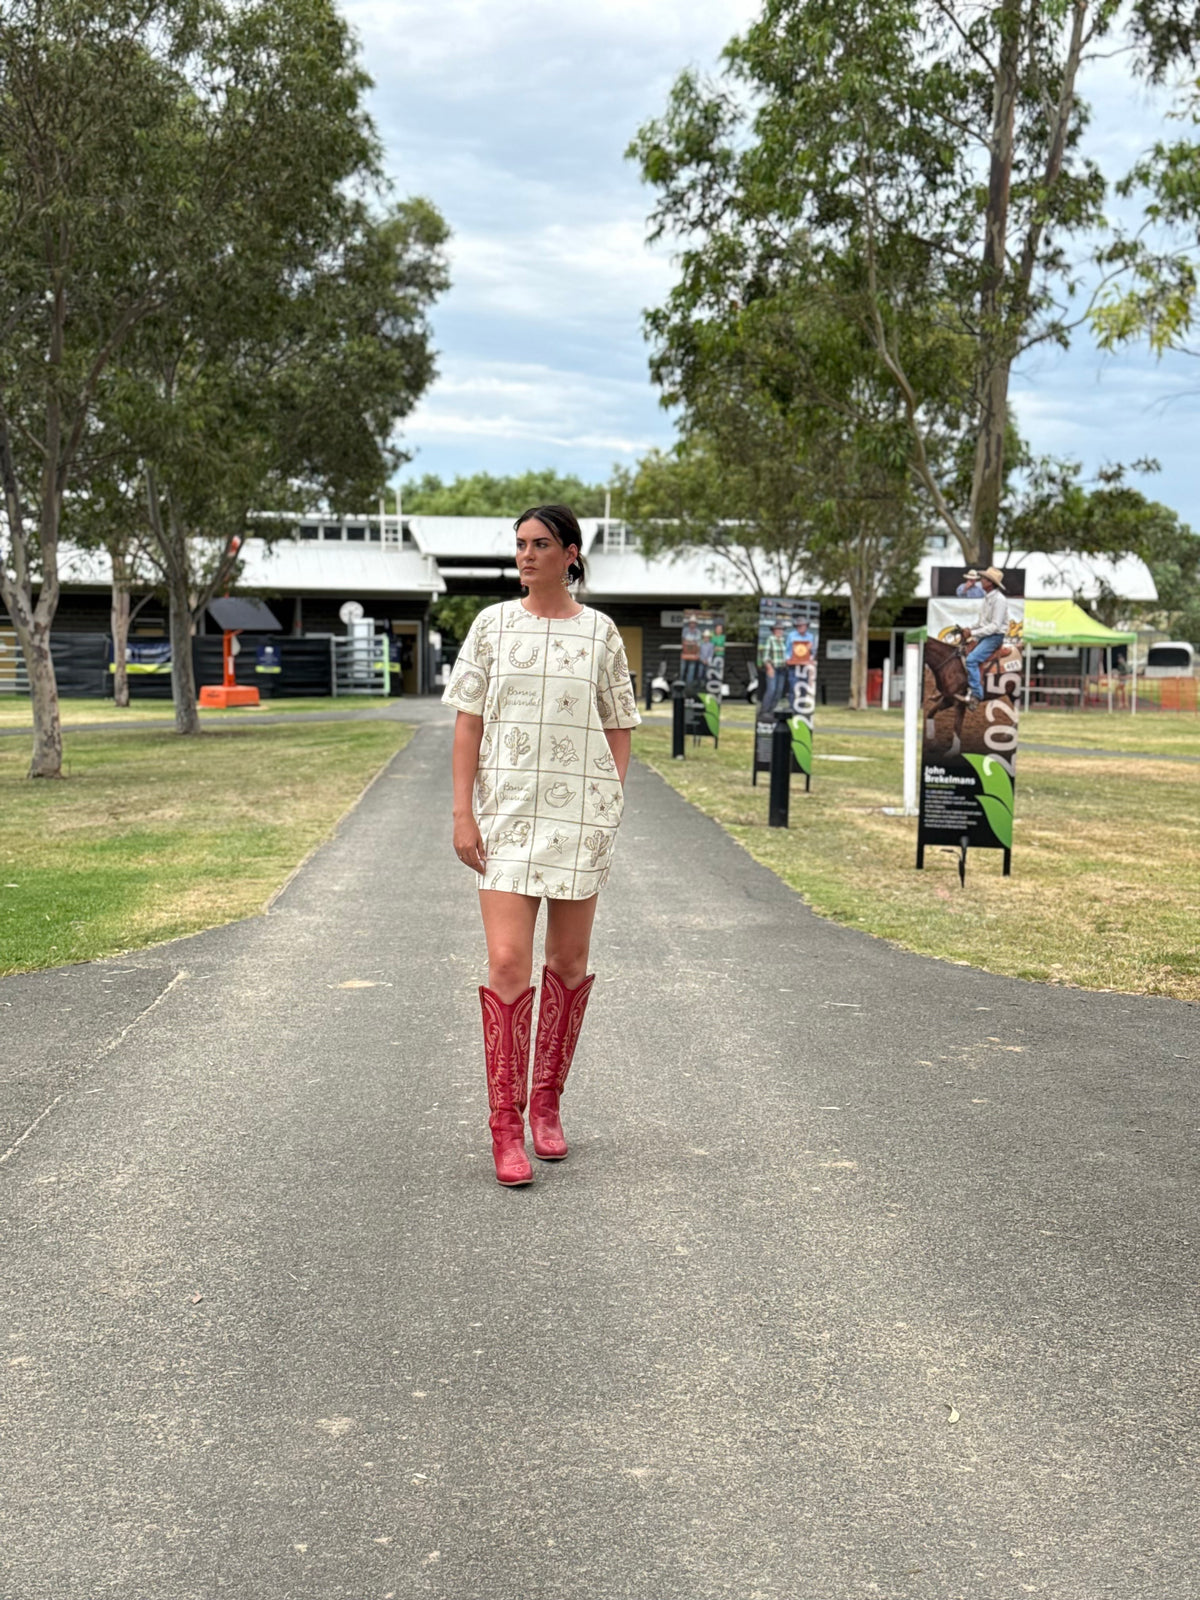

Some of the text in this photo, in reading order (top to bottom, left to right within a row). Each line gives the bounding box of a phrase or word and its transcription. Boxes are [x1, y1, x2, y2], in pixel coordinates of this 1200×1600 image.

[706, 656, 724, 704] 2025
[792, 664, 817, 730] 2025
[983, 672, 1022, 777] 2025
[924, 765, 946, 775] John
[924, 775, 976, 785] Brekelmans
